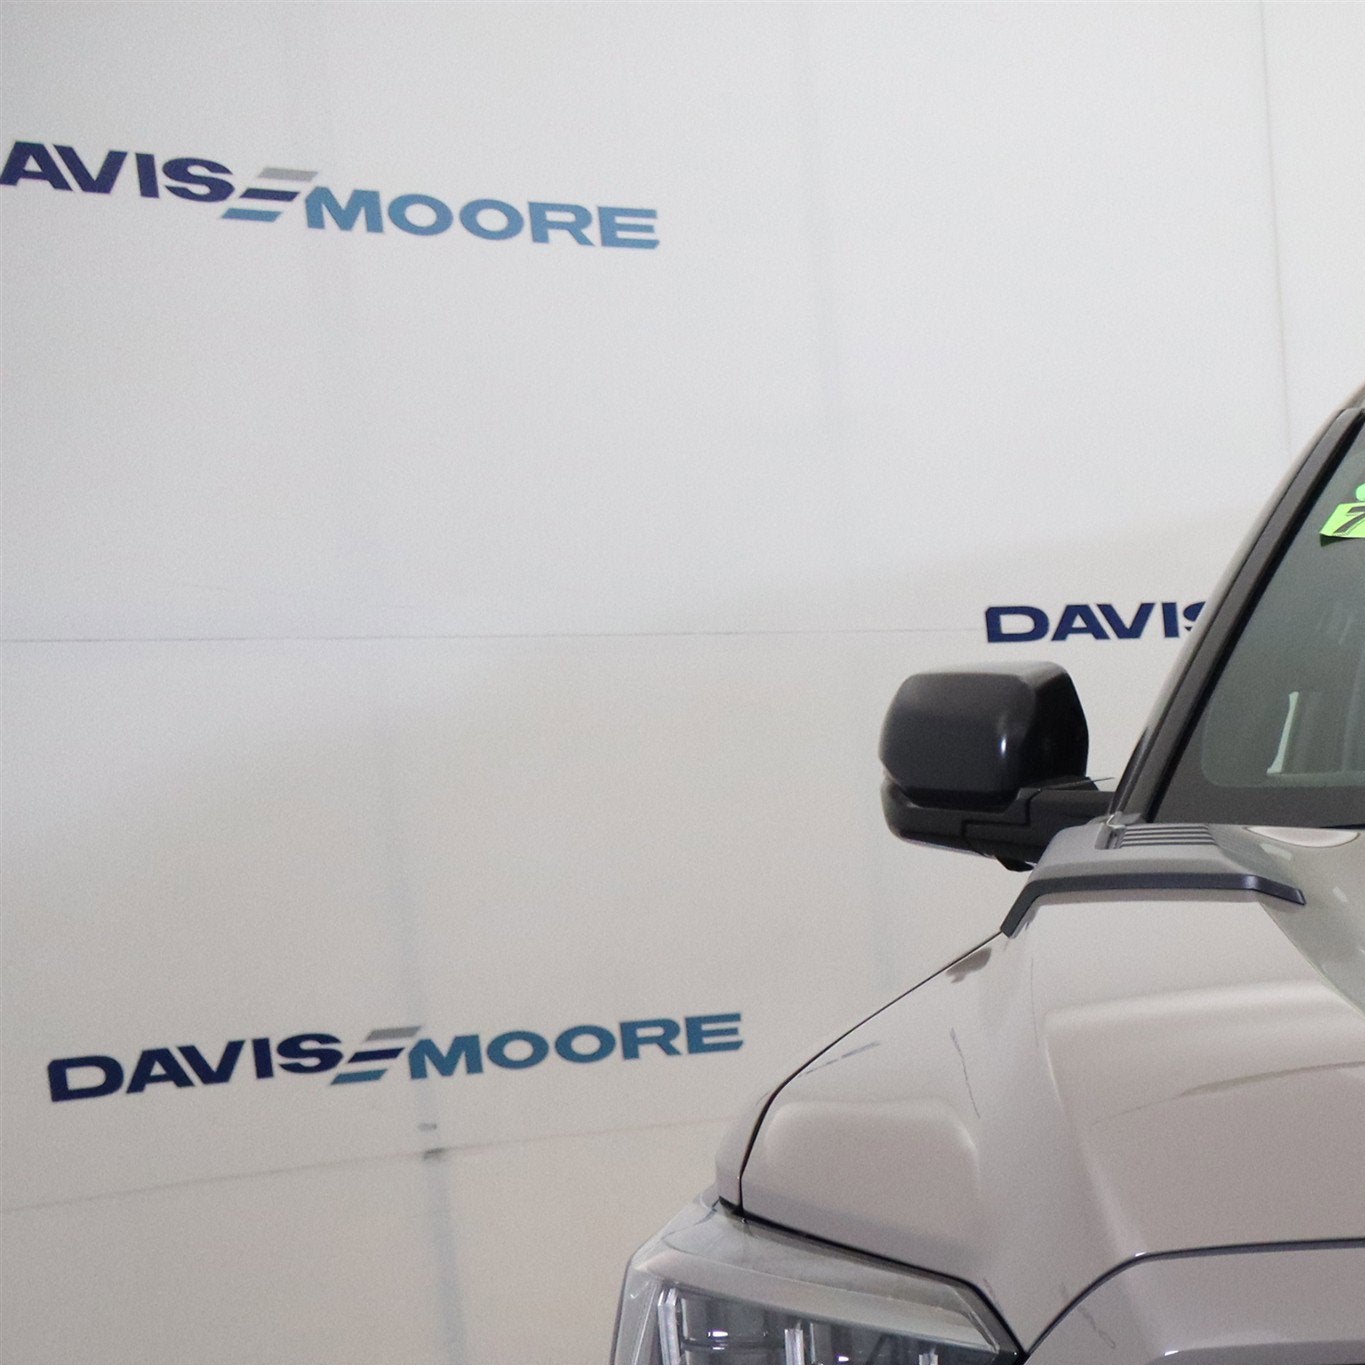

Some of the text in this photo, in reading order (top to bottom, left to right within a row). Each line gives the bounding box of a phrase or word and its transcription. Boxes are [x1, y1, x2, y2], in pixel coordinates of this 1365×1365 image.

[0, 140, 660, 249] AVIS MOORE
[47, 1012, 745, 1102] DAVIS MOORE
